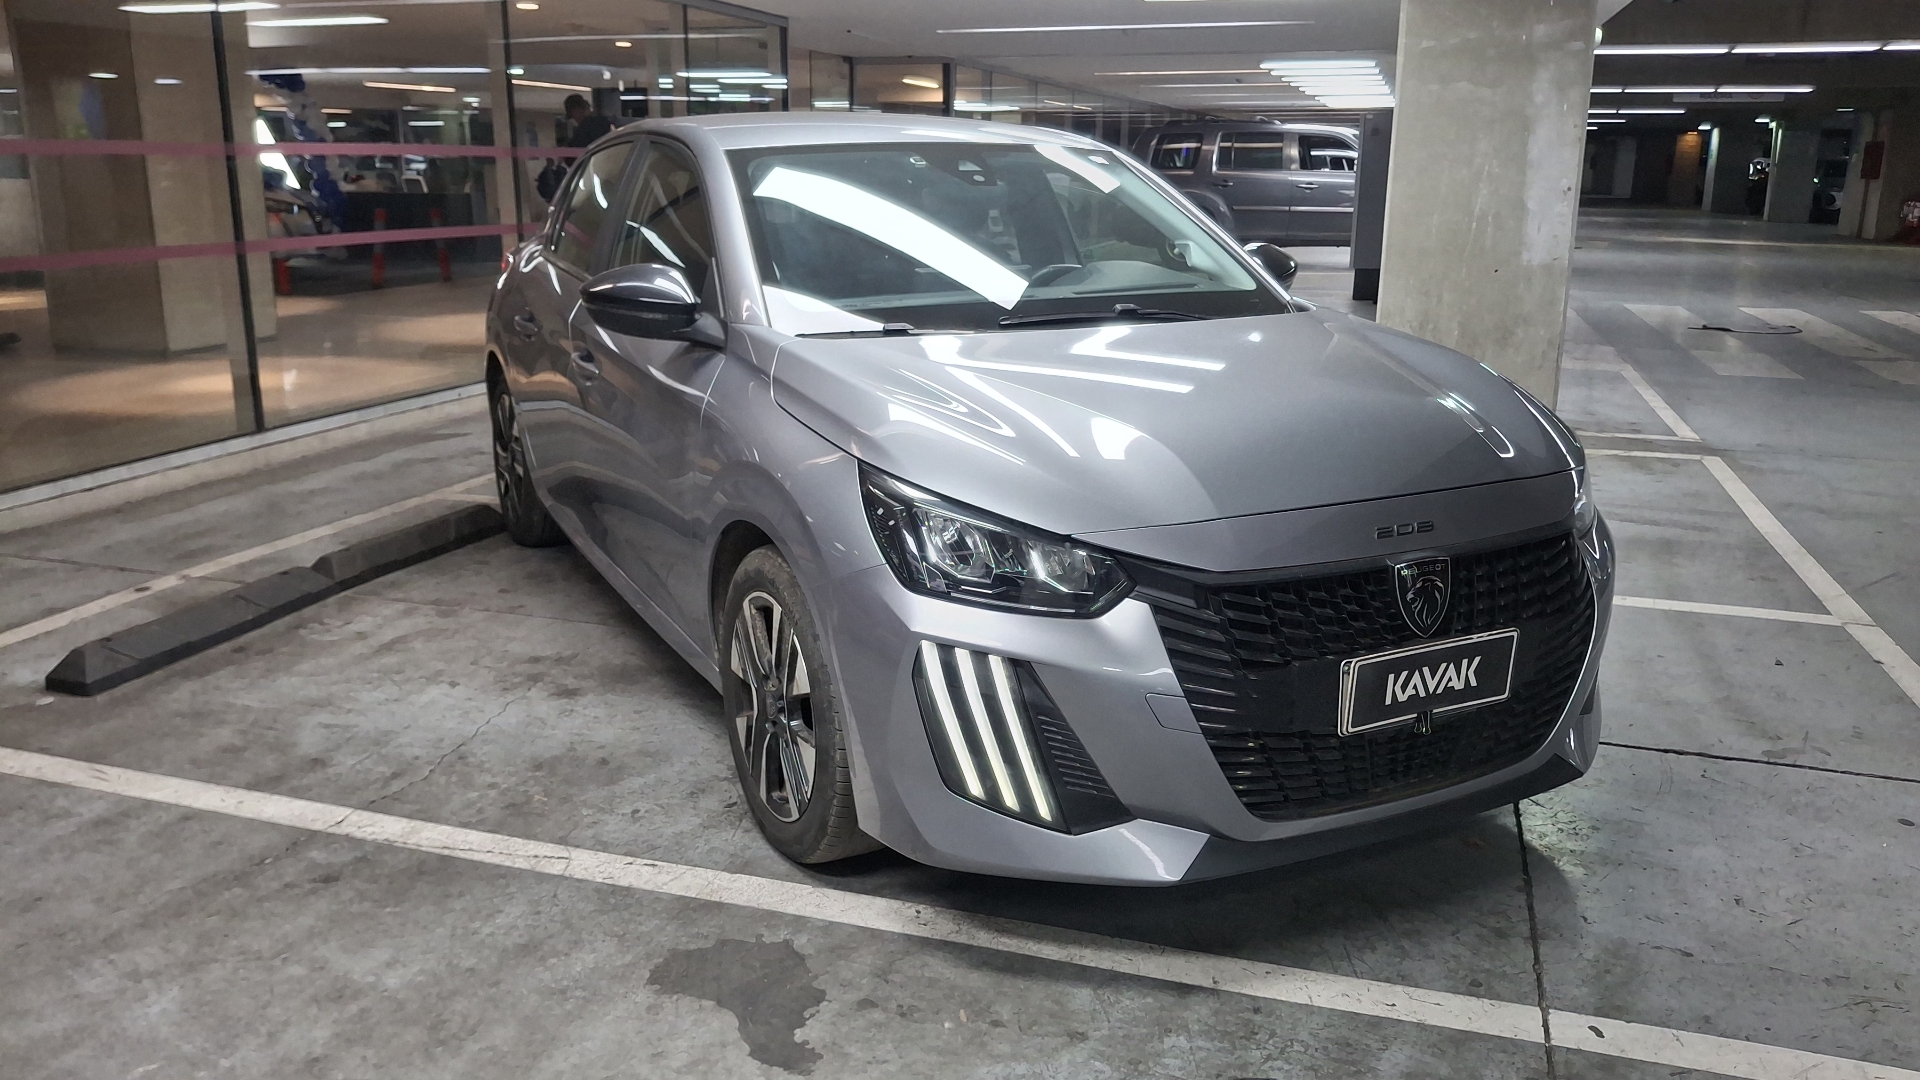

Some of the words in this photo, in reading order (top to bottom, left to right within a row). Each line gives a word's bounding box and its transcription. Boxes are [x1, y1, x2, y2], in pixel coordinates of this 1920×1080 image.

[1374, 520, 1434, 539] 208
[1401, 563, 1446, 576] PEUGEOT
[1385, 655, 1482, 705] KAVAK
